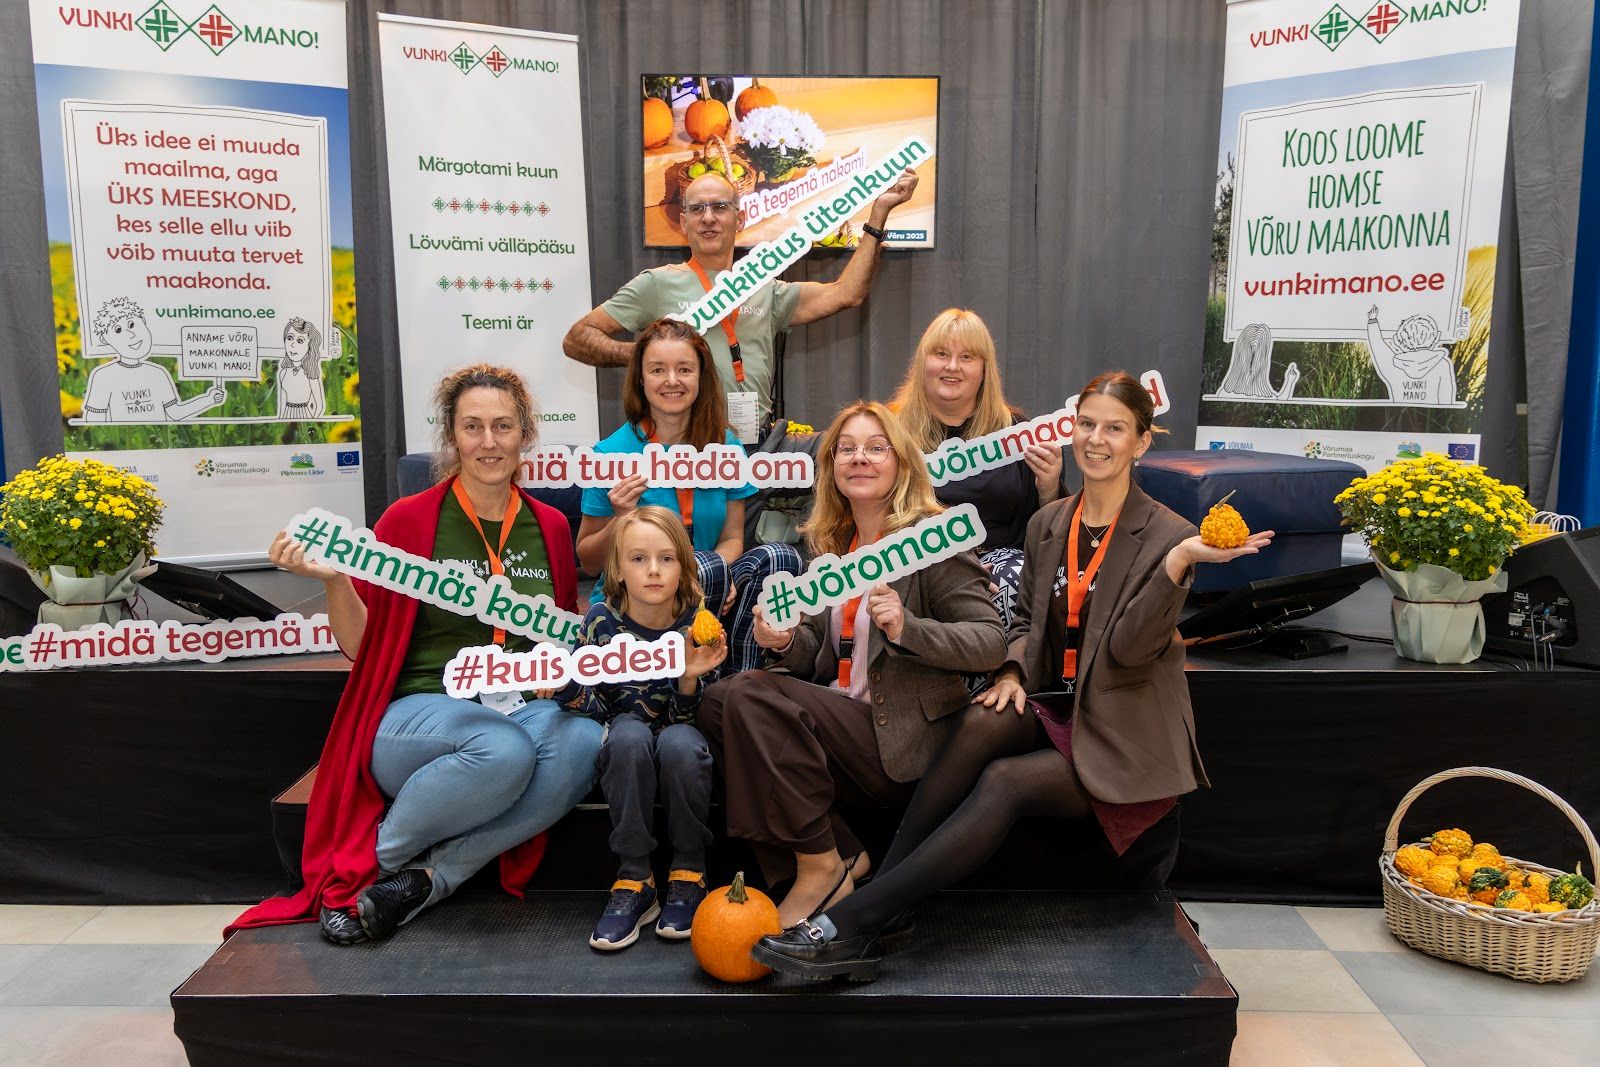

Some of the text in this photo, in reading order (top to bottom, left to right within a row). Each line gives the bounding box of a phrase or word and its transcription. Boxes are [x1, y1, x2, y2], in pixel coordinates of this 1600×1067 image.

[59, 6, 319, 49] VUNKI MANO!
[1250, 0, 1487, 48] VUNKI MANO!
[402, 46, 559, 74] VUNKI MANO!
[96, 121, 300, 157] Üks idee ei muuda
[1282, 119, 1427, 168] KOOS LOOME
[124, 159, 278, 183] maailma, aga
[418, 155, 558, 180] Märgotami kuun
[764, 173, 818, 212] tegemä
[821, 152, 865, 186] nakami
[803, 140, 928, 236] ütenkuun
[1307, 170, 1384, 209] HOMSE
[107, 181, 297, 214] ÜKS MEESKOND,
[116, 213, 292, 238] kes selle ellu viib
[887, 231, 925, 240] Võru 2025
[1247, 209, 1450, 257] VÕRU MAAKONNA
[106, 242, 304, 265] võib muuta tervet
[409, 233, 575, 257] Lövvämi välläpääsu
[146, 271, 271, 290] maakonda.
[1244, 271, 1445, 297] vunkimano.ee
[155, 303, 276, 319] vunkimano.ee
[461, 313, 534, 330] Teemi är
[186, 331, 254, 344] ANNAME VÕRU
[188, 361, 251, 371] VUNKI MANO!
[189, 348, 251, 358] MAAKONNALE
[121, 387, 152, 401] VUNKI
[1402, 380, 1427, 390] VUNKI
[579, 454, 638, 481] tuu
[651, 450, 740, 481] hädä
[751, 458, 807, 481] om
[294, 516, 478, 608] #kimmäs
[511, 567, 549, 580] MANO!
[766, 513, 977, 622] #võromaa
[30, 627, 155, 663] #midä
[166, 620, 301, 655] tegemä
[452, 638, 677, 691] #kuis edesi
